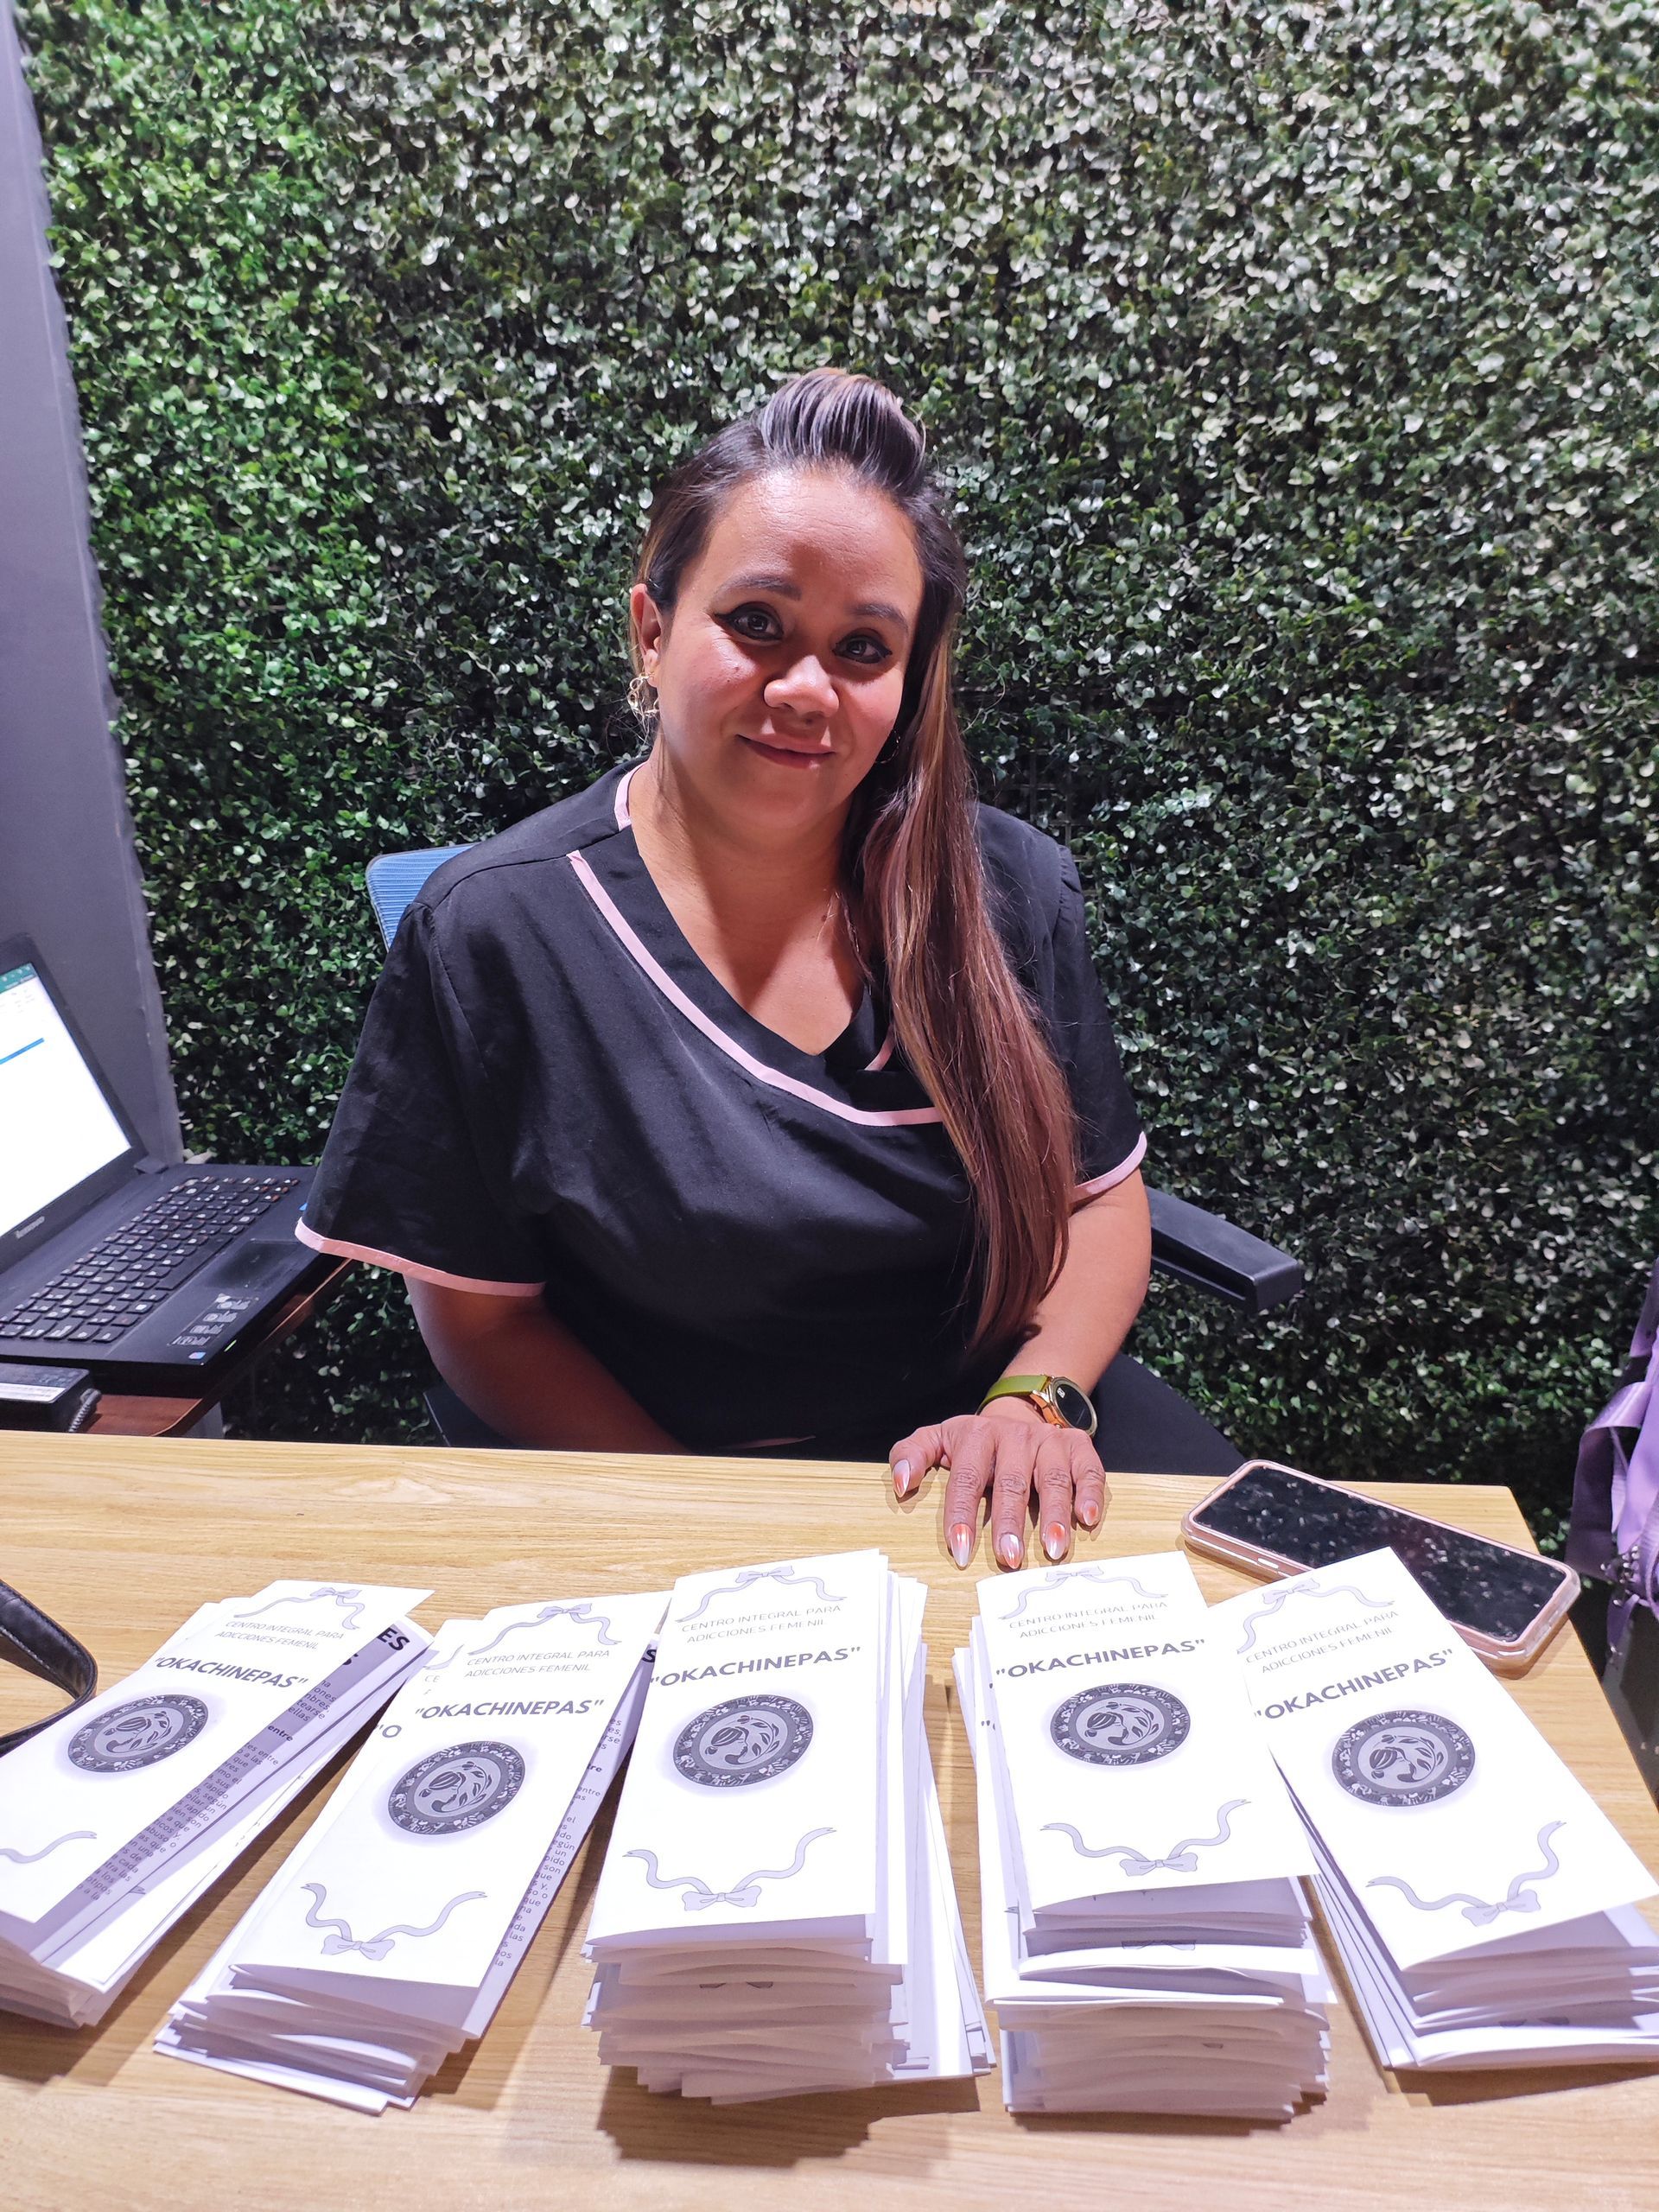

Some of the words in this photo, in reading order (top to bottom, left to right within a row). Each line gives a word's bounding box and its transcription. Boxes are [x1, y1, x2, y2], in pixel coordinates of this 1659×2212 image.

[682, 1618, 734, 1632] CENTRO
[738, 1611, 802, 1624] INTEGRAL
[806, 1605, 842, 1614] PARA
[226, 1620, 264, 1630] CENTRO
[265, 1624, 313, 1637] INTEGRAL
[316, 1630, 346, 1640] PARA
[686, 1626, 766, 1643] ADICCIONES
[769, 1619, 827, 1631] FEMENIL
[1246, 1641, 1298, 1663] CENTRO
[1299, 1621, 1361, 1648] INTEGRAL
[1363, 1610, 1399, 1624] PARA
[214, 1630, 274, 1643] ADICCIONES
[274, 1637, 319, 1649] FEMENIL
[467, 1654, 515, 1666] CENTRO
[516, 1650, 575, 1662] INTEGRAL
[576, 1649, 610, 1659] PARA
[995, 1638, 1205, 1678] "OKACHINEPAS"
[1262, 1643, 1338, 1674] ADICCIONES
[1340, 1627, 1394, 1648] FEMENIL
[154, 1656, 309, 1688] "OKACHINEPAS"
[464, 1665, 537, 1678] ADICCIONES
[538, 1662, 590, 1673] FEMENIL
[650, 1646, 861, 1687] "OKACHINEPAS"
[1254, 1649, 1453, 1719] "OKACHINEPAS"
[414, 1700, 605, 1719] "OKACHINEPAS"
[268, 1725, 293, 1742] entre
[233, 1756, 249, 1768] que
[251, 1754, 264, 1765] las
[258, 1751, 279, 1765] entre
[216, 1778, 230, 1789] sus
[203, 1792, 227, 1810] según
[185, 1803, 209, 1821] rápido
[205, 1805, 215, 1815] un
[175, 1820, 190, 1833] que
[188, 1816, 201, 1828] son
[138, 1845, 154, 1858] una
[150, 1840, 166, 1853] que
[118, 1857, 138, 1873] cada
[130, 1852, 143, 1862] de
[118, 1870, 132, 1882] las
[543, 1864, 561, 1874] son
[101, 1872, 114, 1884] los
[509, 1931, 524, 1942] las
